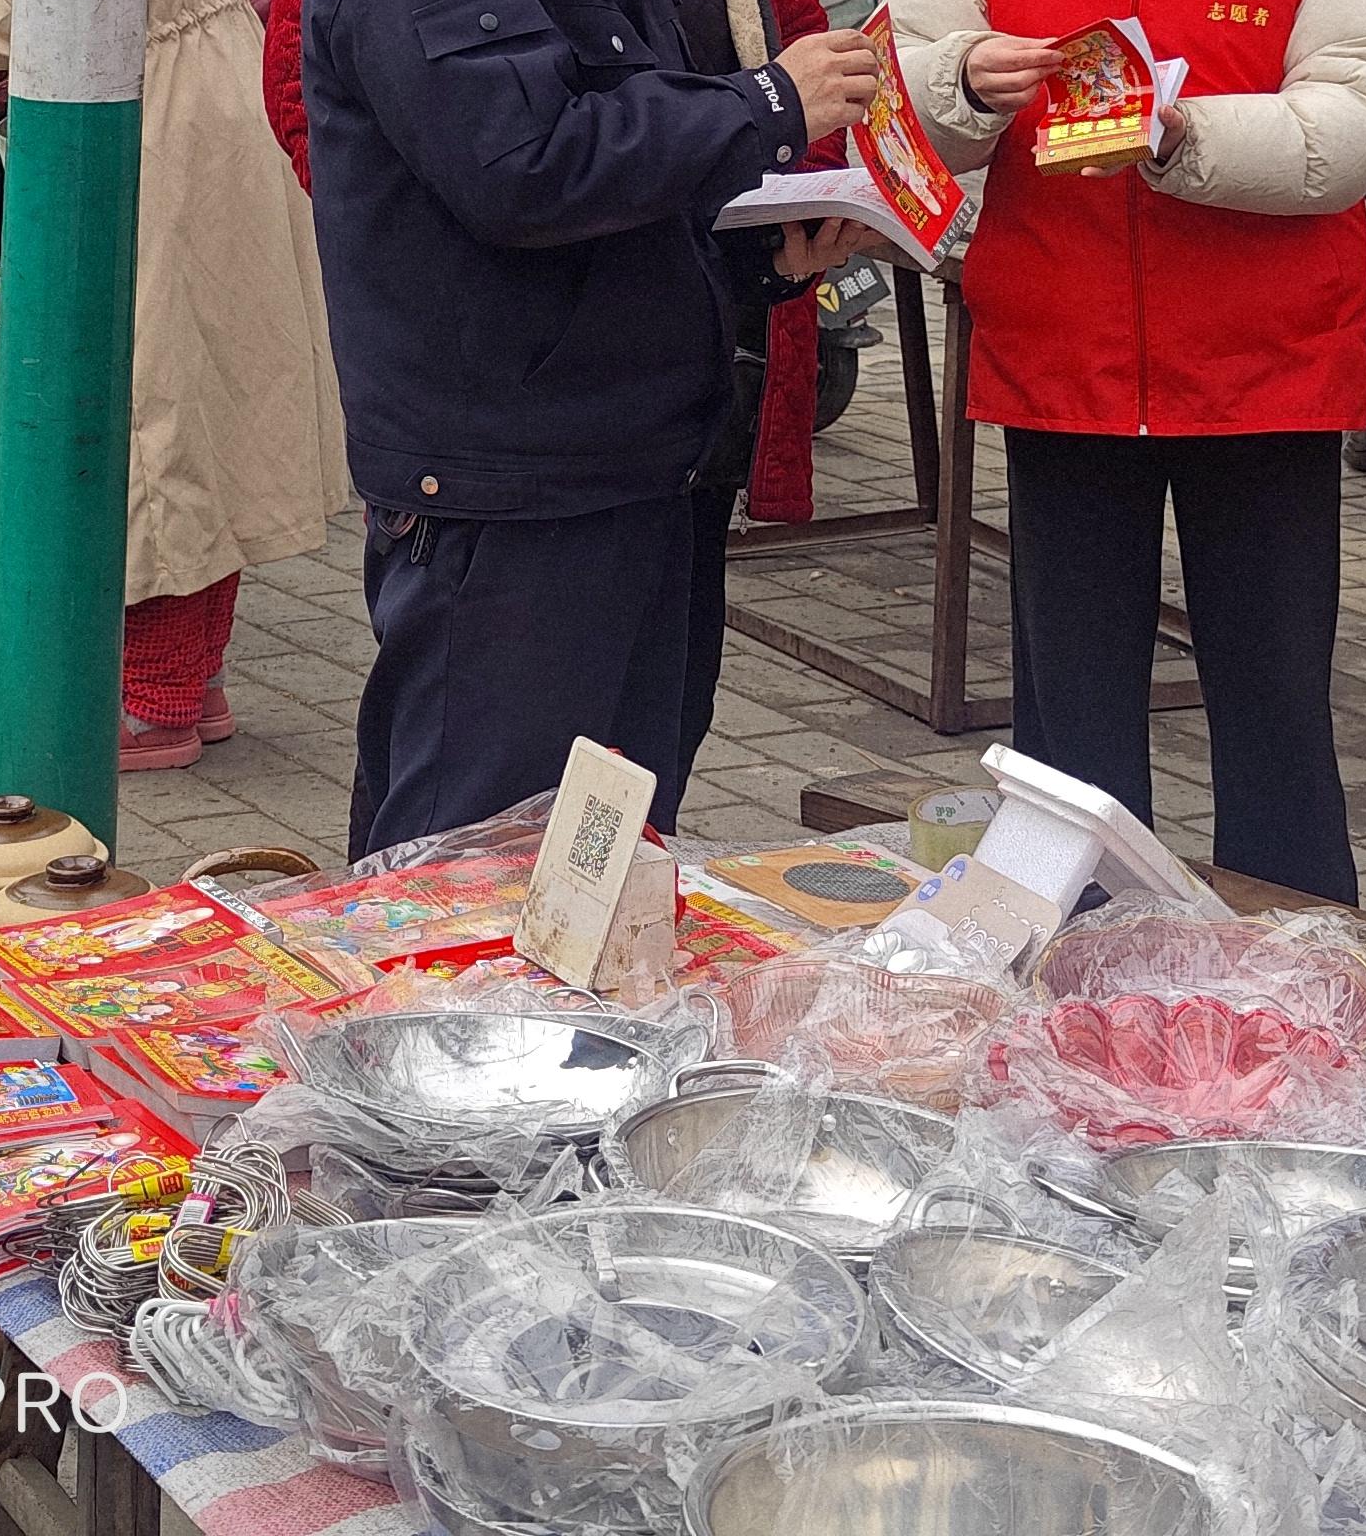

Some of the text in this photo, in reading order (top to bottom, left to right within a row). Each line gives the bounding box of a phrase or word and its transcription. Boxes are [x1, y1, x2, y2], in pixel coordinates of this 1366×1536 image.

[1206, 1, 1270, 27] 志愿者
[753, 69, 785, 113] POLICE
[837, 267, 879, 302] 雅迪
